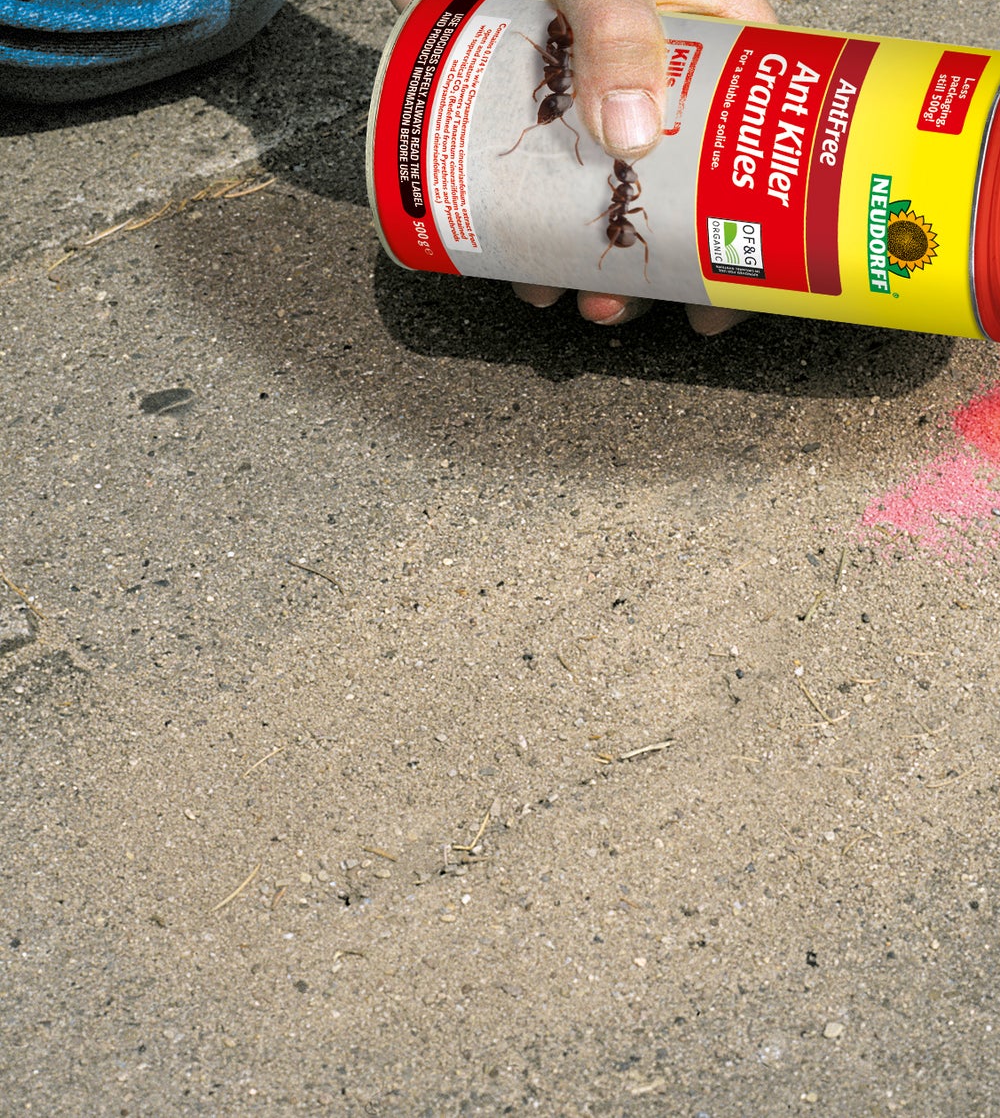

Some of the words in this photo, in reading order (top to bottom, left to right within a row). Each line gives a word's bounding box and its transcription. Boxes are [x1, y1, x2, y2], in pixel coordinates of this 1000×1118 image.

[436, 11, 452, 28] AND
[450, 13, 464, 27] USE
[475, 24, 486, 38] with
[417, 28, 442, 65] PRODUCT
[429, 28, 457, 64] BIOCIDES
[481, 29, 492, 44] open
[487, 23, 507, 49] Contains
[457, 38, 478, 78] supercritical
[474, 45, 484, 57] and
[479, 50, 492, 67] 0.174
[738, 49, 753, 65] For
[450, 59, 459, 72] and
[464, 58, 477, 82] mature
[417, 66, 438, 98] SAFELY.
[723, 74, 742, 108] soluble
[781, 61, 821, 116] Ant
[934, 73, 949, 92] still
[959, 77, 976, 99] Less
[402, 66, 424, 126] INFORMATION
[435, 73, 455, 131] Chrysanthemum
[457, 84, 469, 109] flowers
[923, 94, 941, 122] 500g!
[935, 75, 961, 128] packaging,
[411, 99, 425, 135] ALWAYS
[443, 95, 457, 133] (Redefined
[455, 110, 462, 118] of
[459, 89, 476, 148] Chrysanthemum
[720, 110, 733, 122] or
[732, 53, 788, 190] Granules
[819, 78, 857, 166] AntFree
[399, 128, 410, 162] BEFORE
[410, 136, 420, 161] READ
[442, 134, 450, 152] from
[450, 120, 461, 159] Tanacetum
[714, 124, 731, 148] solid
[410, 163, 420, 180] THE
[440, 154, 449, 190] Pyrethrins
[711, 150, 722, 170] use.
[766, 120, 806, 208] Killer
[399, 164, 409, 183] USE.
[411, 181, 423, 208] LABEL
[434, 188, 442, 204] ext.)
[443, 191, 451, 204] and
[412, 220, 429, 240] 500
[444, 205, 460, 242] Pyrethroids
[455, 212, 468, 240] obtained
[462, 208, 472, 232] extract
[417, 240, 430, 248] g
[468, 232, 478, 248] from
[712, 220, 723, 262] ORGANIC
[742, 224, 757, 266] OF&G
[869, 177, 890, 291] NEUDORFF
